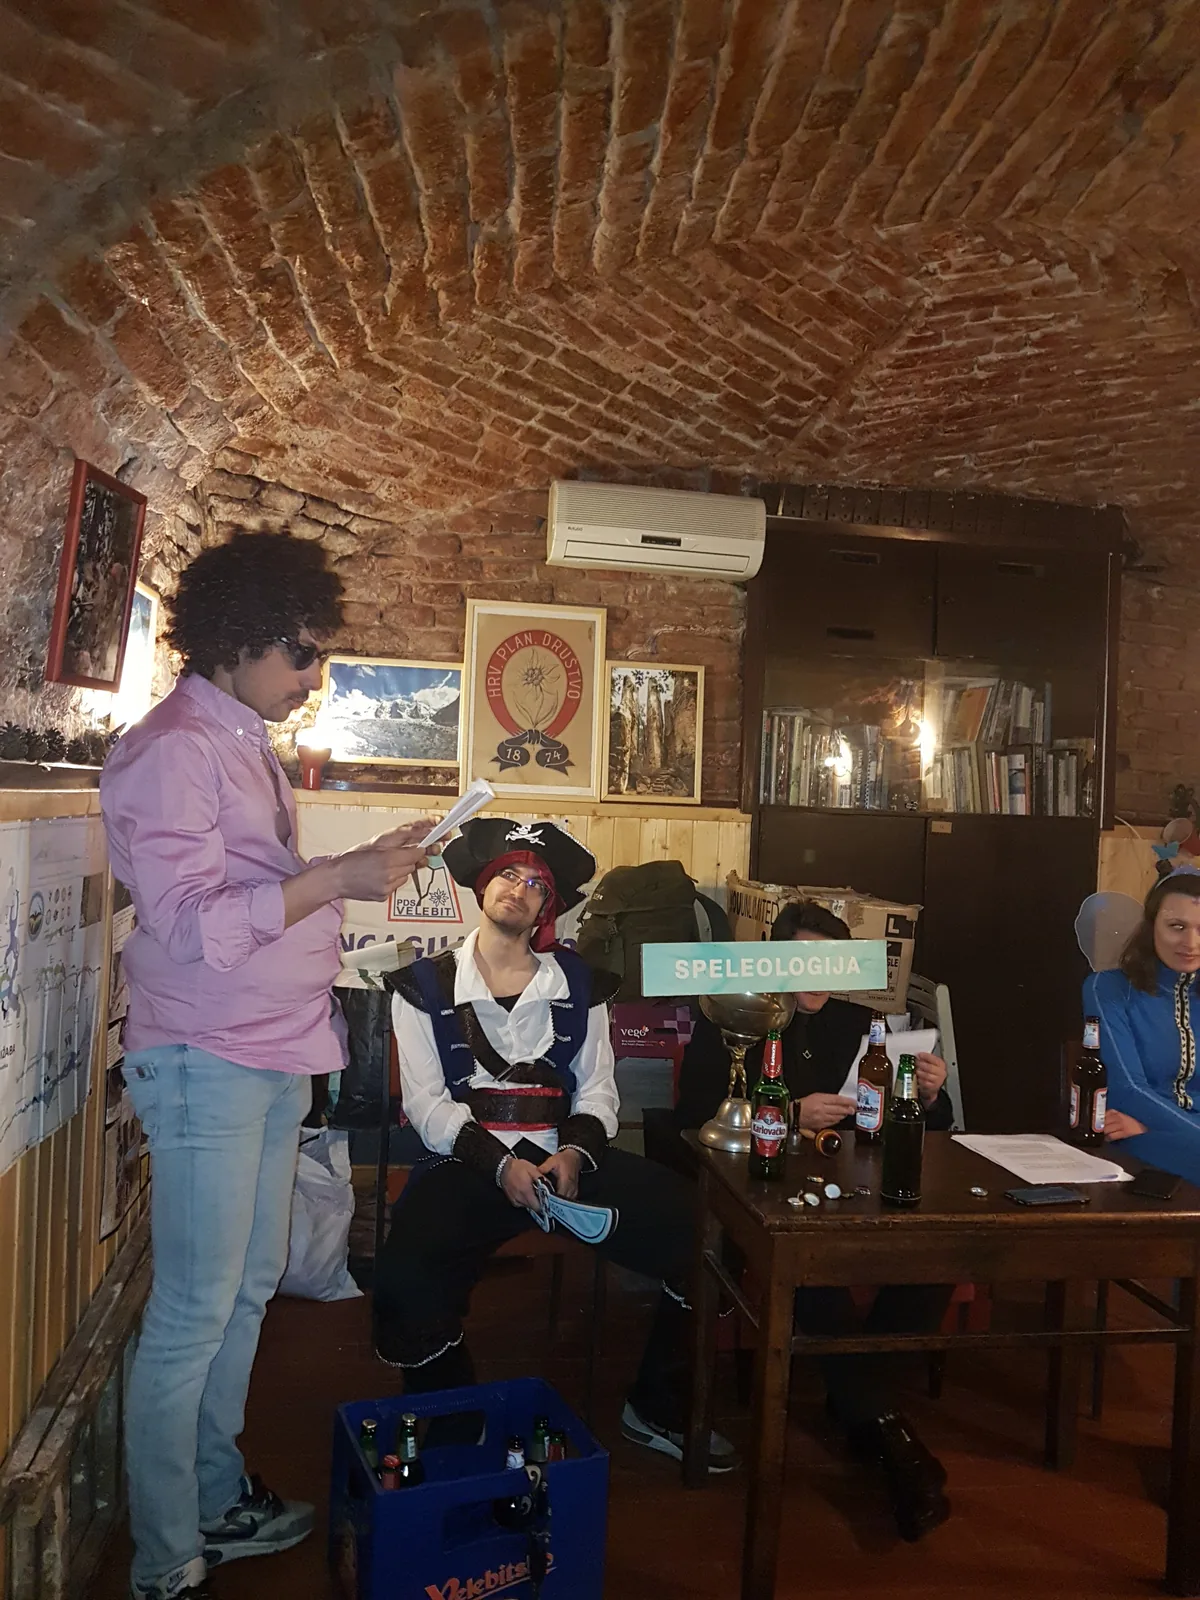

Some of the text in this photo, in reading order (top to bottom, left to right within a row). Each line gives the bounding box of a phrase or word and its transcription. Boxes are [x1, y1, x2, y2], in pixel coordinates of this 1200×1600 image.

[496, 632, 537, 661] PLAN.
[506, 748, 561, 762] 18 74
[397, 899, 416, 907] PDS
[397, 906, 451, 916] VELEBIT
[675, 956, 861, 979] SPELEOLOGIJA
[621, 1028, 647, 1039] vego
